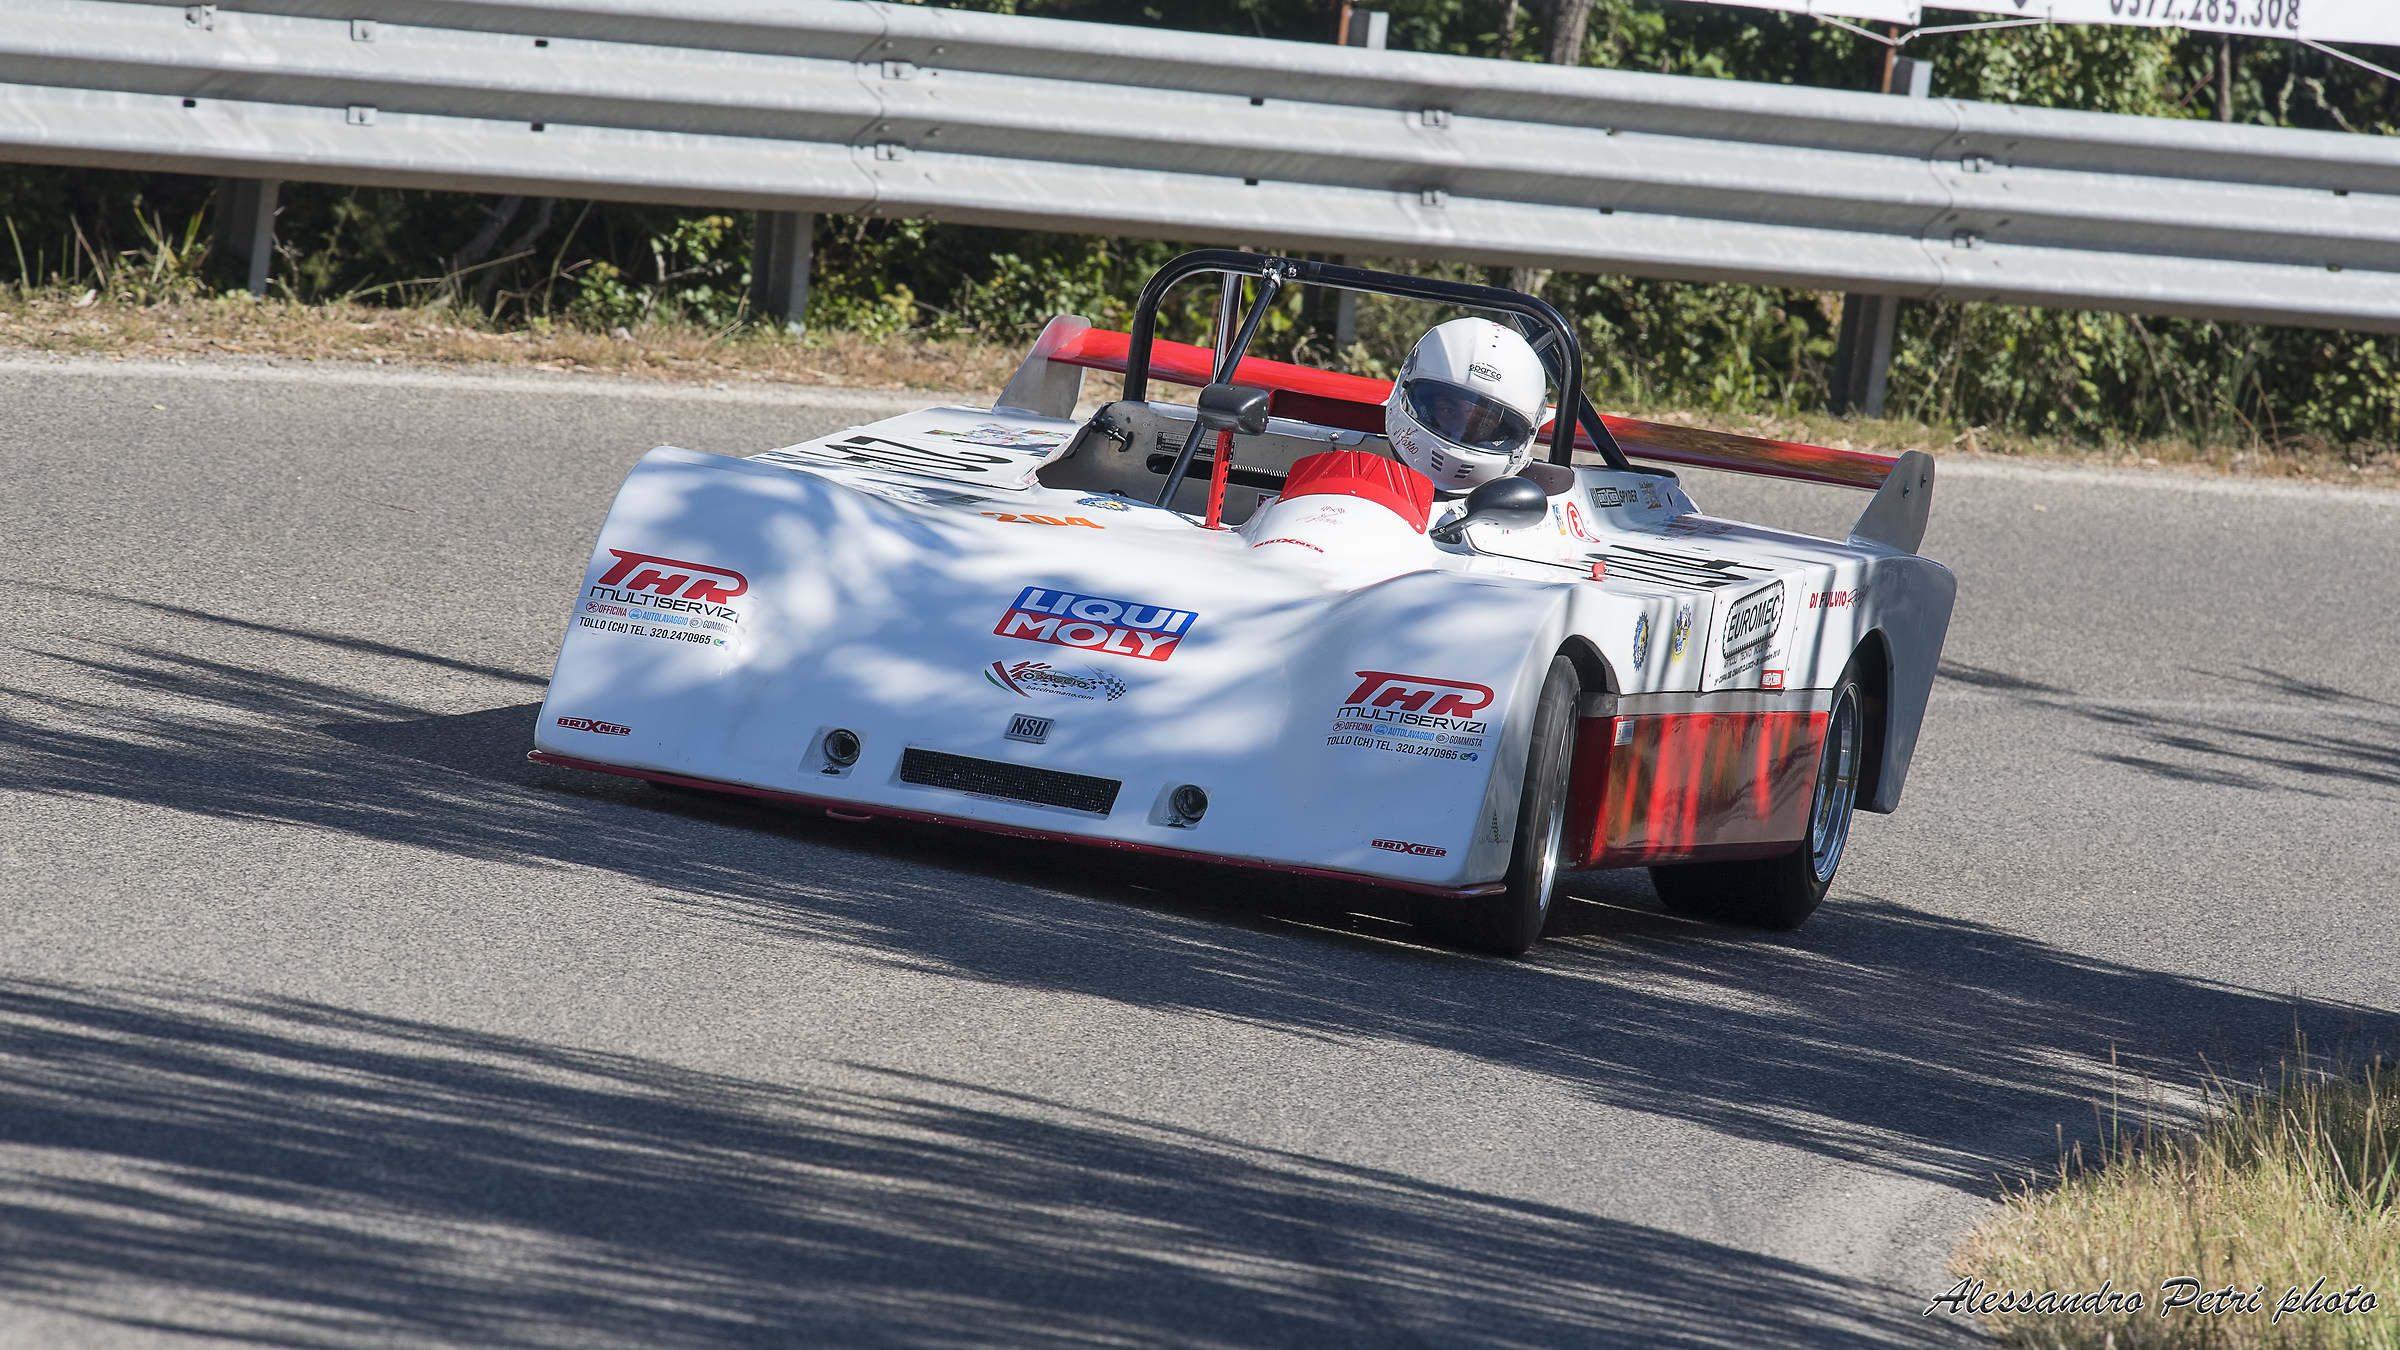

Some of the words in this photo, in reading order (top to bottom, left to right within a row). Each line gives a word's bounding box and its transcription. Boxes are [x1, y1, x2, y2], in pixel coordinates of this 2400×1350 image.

[1469, 363, 1502, 381] sparco
[1619, 489, 1639, 503] SPYDER
[980, 512, 1106, 529] 204
[598, 548, 749, 604] THR
[589, 586, 740, 623] MULTISERVIZI
[1020, 589, 1190, 633] LIQUI
[1809, 592, 1819, 608] DI
[1819, 591, 1847, 608] FULVIO
[598, 604, 628, 617] OFFICINA
[641, 611, 689, 625] AUTOLAVAGGIO
[1727, 594, 1780, 643] EUROMEC
[579, 617, 606, 630] TOLLO
[630, 625, 647, 637] TEL.
[650, 628, 711, 645] 320.2470965
[1003, 612, 1178, 656] MOLY
[1026, 685, 1094, 701] bacciromano.com
[1345, 671, 1495, 718] THR
[557, 717, 632, 736] BRIXNER
[1010, 718, 1048, 737] NSU
[1336, 706, 1487, 734] MULTISERVIZI
[1345, 722, 1373, 732] OFFICINA
[1387, 727, 1435, 742] AUTOLAVAGGIO
[1449, 736, 1483, 747] GOMMISTA
[1326, 735, 1352, 746] TOLLO
[1376, 739, 1393, 751] TEL.
[1396, 743, 1459, 760] 320.2470965
[1371, 839, 1447, 858] BRIXNER
